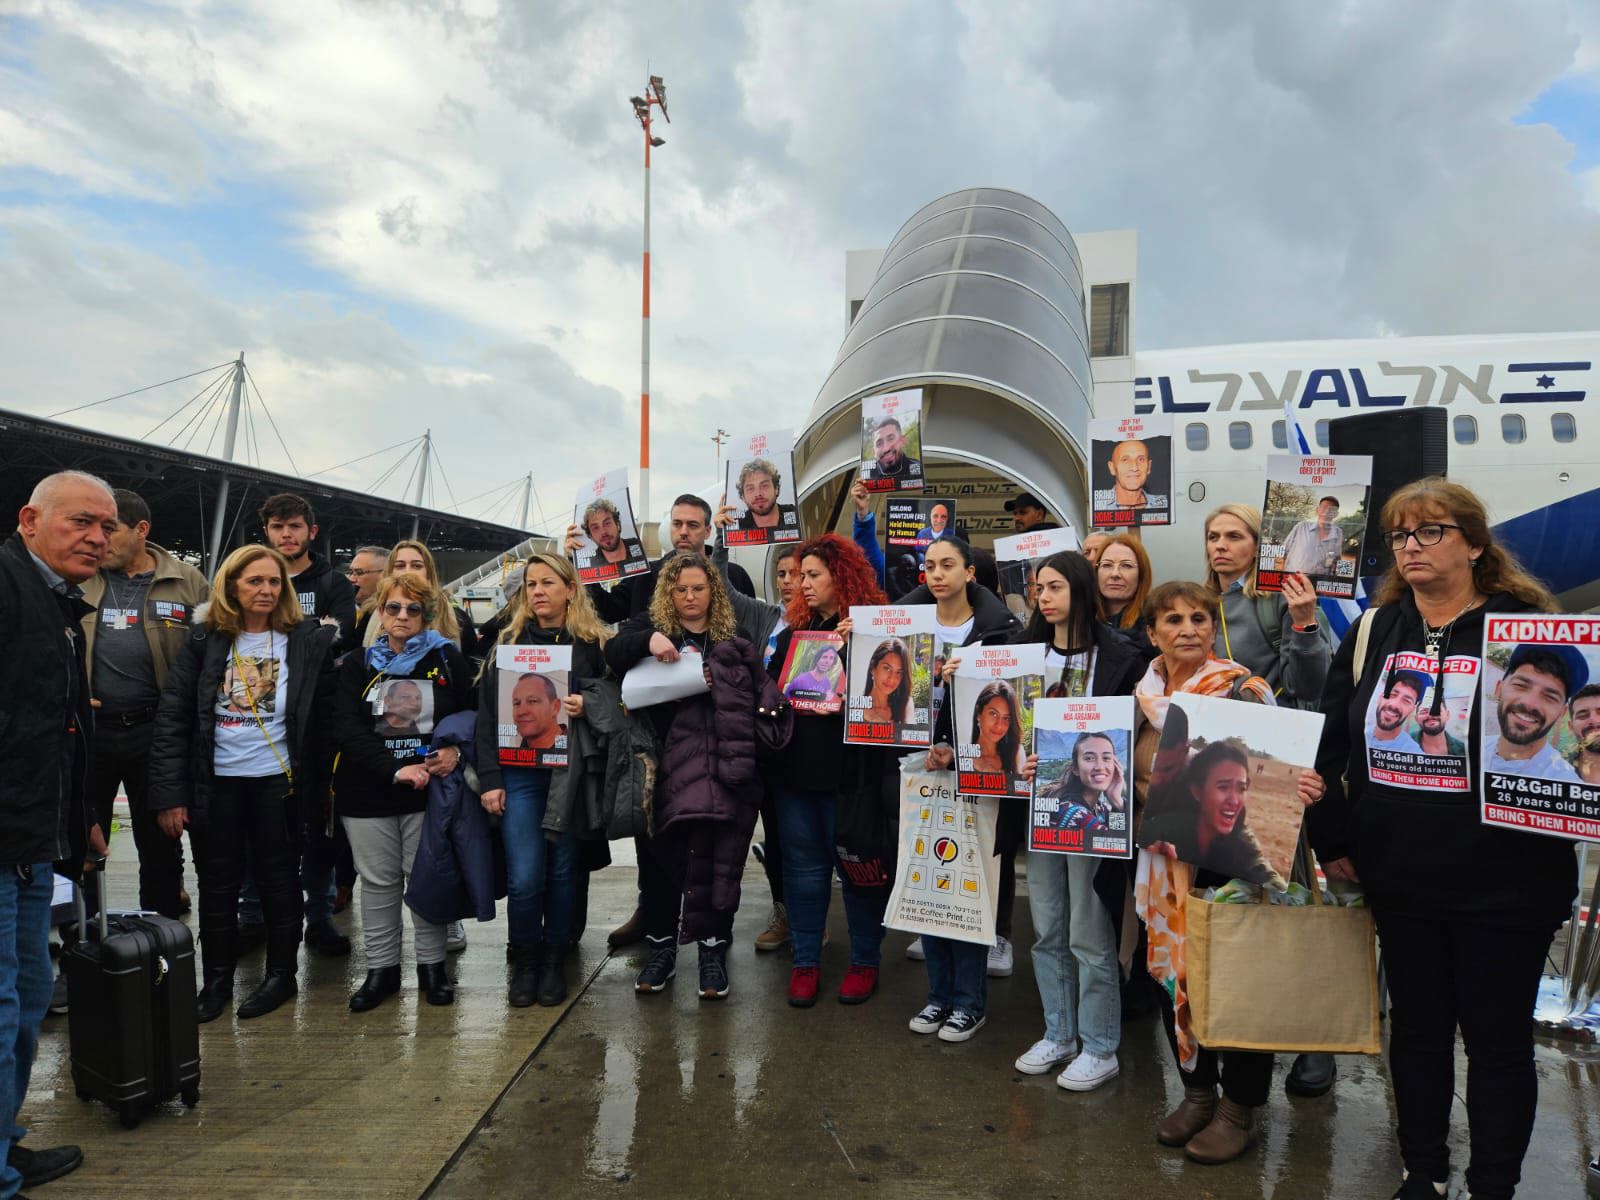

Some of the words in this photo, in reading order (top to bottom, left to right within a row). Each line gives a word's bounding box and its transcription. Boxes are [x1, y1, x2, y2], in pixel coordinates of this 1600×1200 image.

[1134, 376, 1211, 414] EL
[1298, 368, 1406, 408] AL
[726, 531, 745, 541] HOME
[747, 528, 768, 540] NOW!
[1261, 545, 1286, 557] BRING
[578, 567, 599, 579] HOME
[600, 564, 619, 577] NOW!
[849, 696, 873, 708] BRING
[849, 709, 864, 722] HER
[848, 724, 871, 737] HOME
[872, 723, 894, 738] NOW!
[499, 749, 517, 760] HOME
[958, 743, 981, 757] BRING
[959, 758, 974, 771] HER
[1372, 750, 1413, 763] Ziv&Gali
[1417, 756, 1462, 766] Berman
[1386, 763, 1407, 771] years
[1425, 766, 1457, 774] Israelis
[960, 774, 982, 788] HOME
[983, 774, 1007, 789] NOW!
[1372, 770, 1392, 781] BRING
[1393, 773, 1414, 784] THEM
[1416, 777, 1440, 786] HOME
[1442, 778, 1465, 787] NOW!
[1490, 774, 1563, 797] Ziv&Gali
[1034, 797, 1060, 812] BRING
[1497, 791, 1511, 802] 26
[1516, 794, 1550, 809] years
[1555, 801, 1576, 812] old
[1581, 804, 1600, 816] Isr
[1034, 812, 1051, 827] HER
[1488, 807, 1525, 824] BRING
[1529, 813, 1563, 830] THEM
[1033, 827, 1057, 844] HOME
[1058, 828, 1084, 846] NOW!
